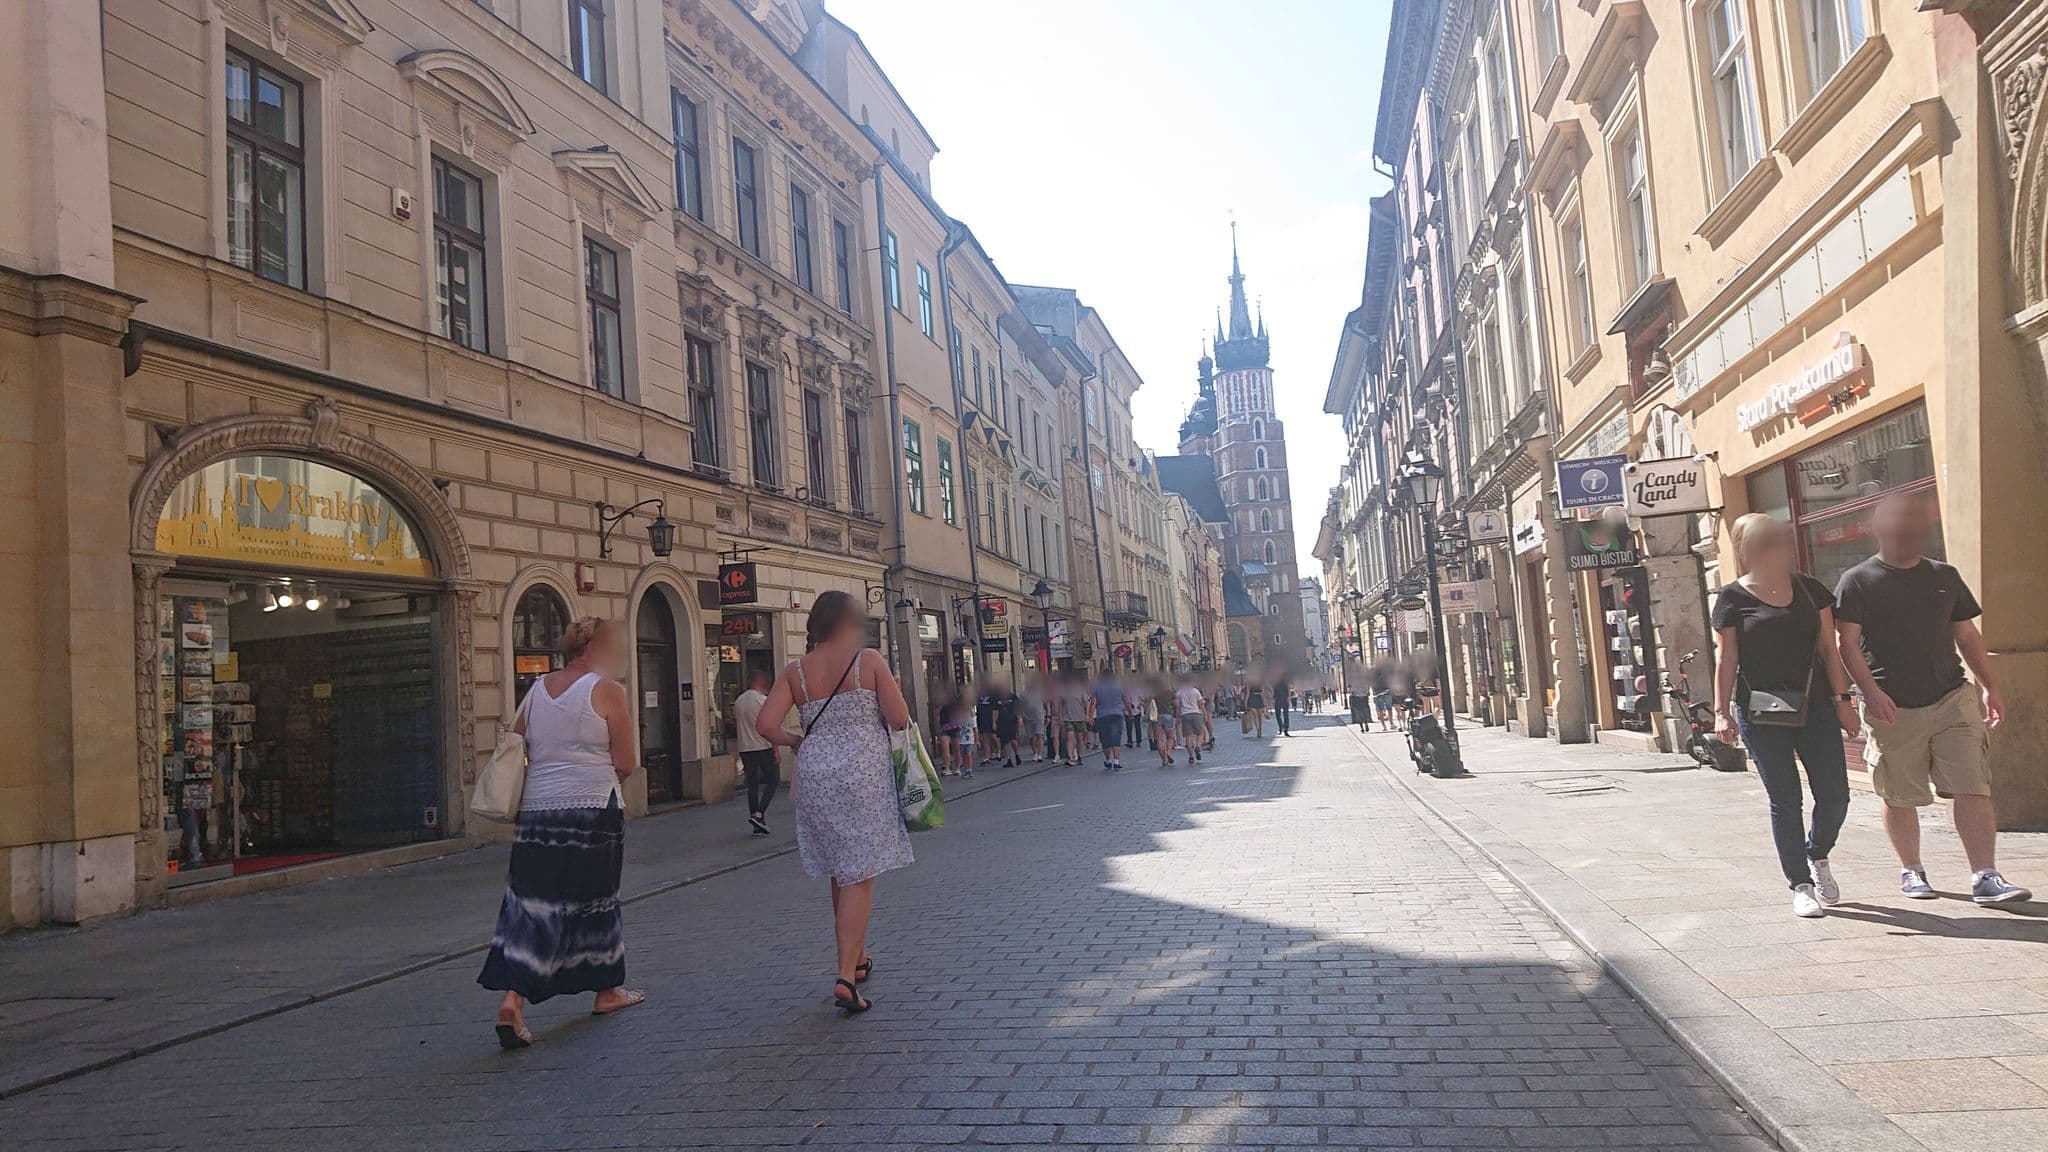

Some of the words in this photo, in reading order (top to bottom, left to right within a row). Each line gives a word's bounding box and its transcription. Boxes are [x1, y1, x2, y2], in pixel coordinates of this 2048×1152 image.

[1645, 469, 1697, 488] Candy
[288, 483, 383, 526] Kraków
[1633, 482, 1677, 508] Land
[1570, 553, 1599, 569] SUMO
[1600, 550, 1634, 566] BISTRO
[721, 589, 750, 600] express
[723, 619, 756, 635] 24h
